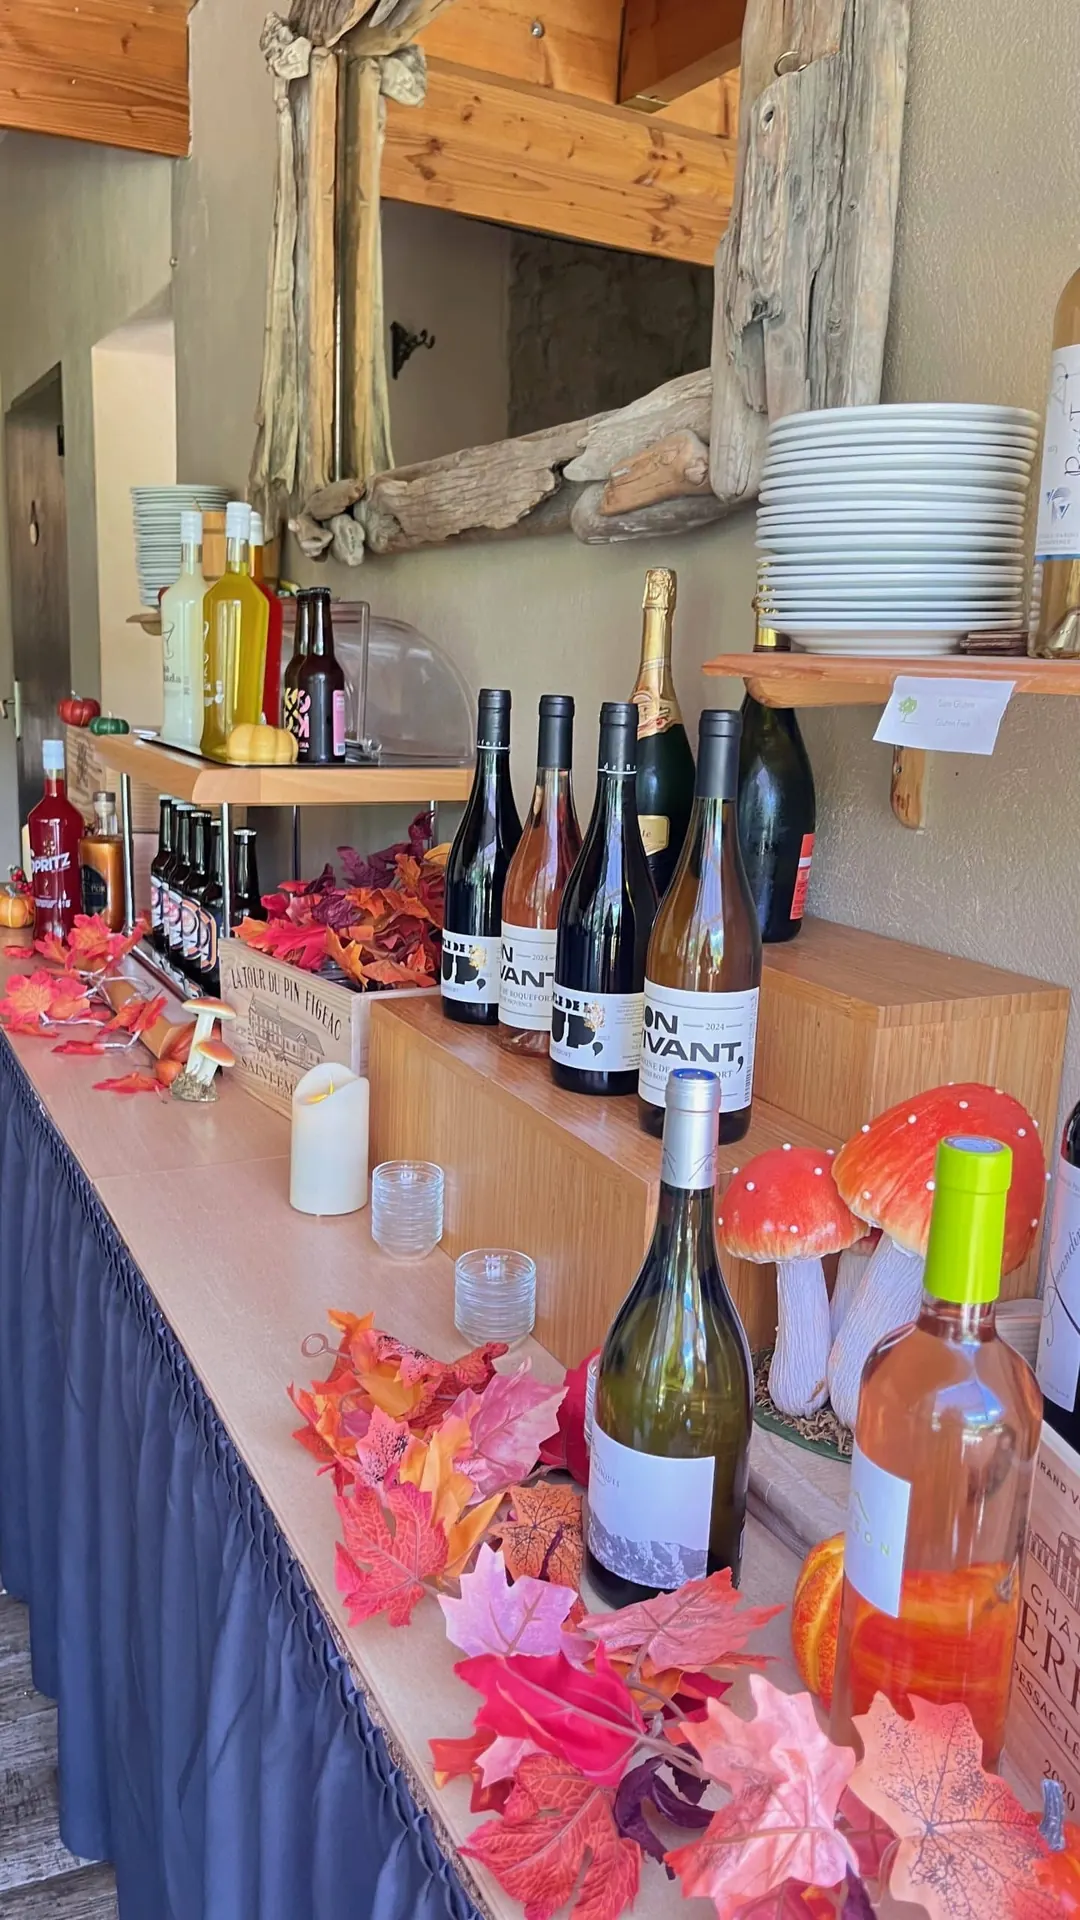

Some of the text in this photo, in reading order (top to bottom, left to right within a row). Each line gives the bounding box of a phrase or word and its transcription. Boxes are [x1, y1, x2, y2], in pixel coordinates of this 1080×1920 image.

[230, 965, 342, 1042] LA TOUR DU PIN FIGEAC
[705, 1022, 726, 1031] 2024
